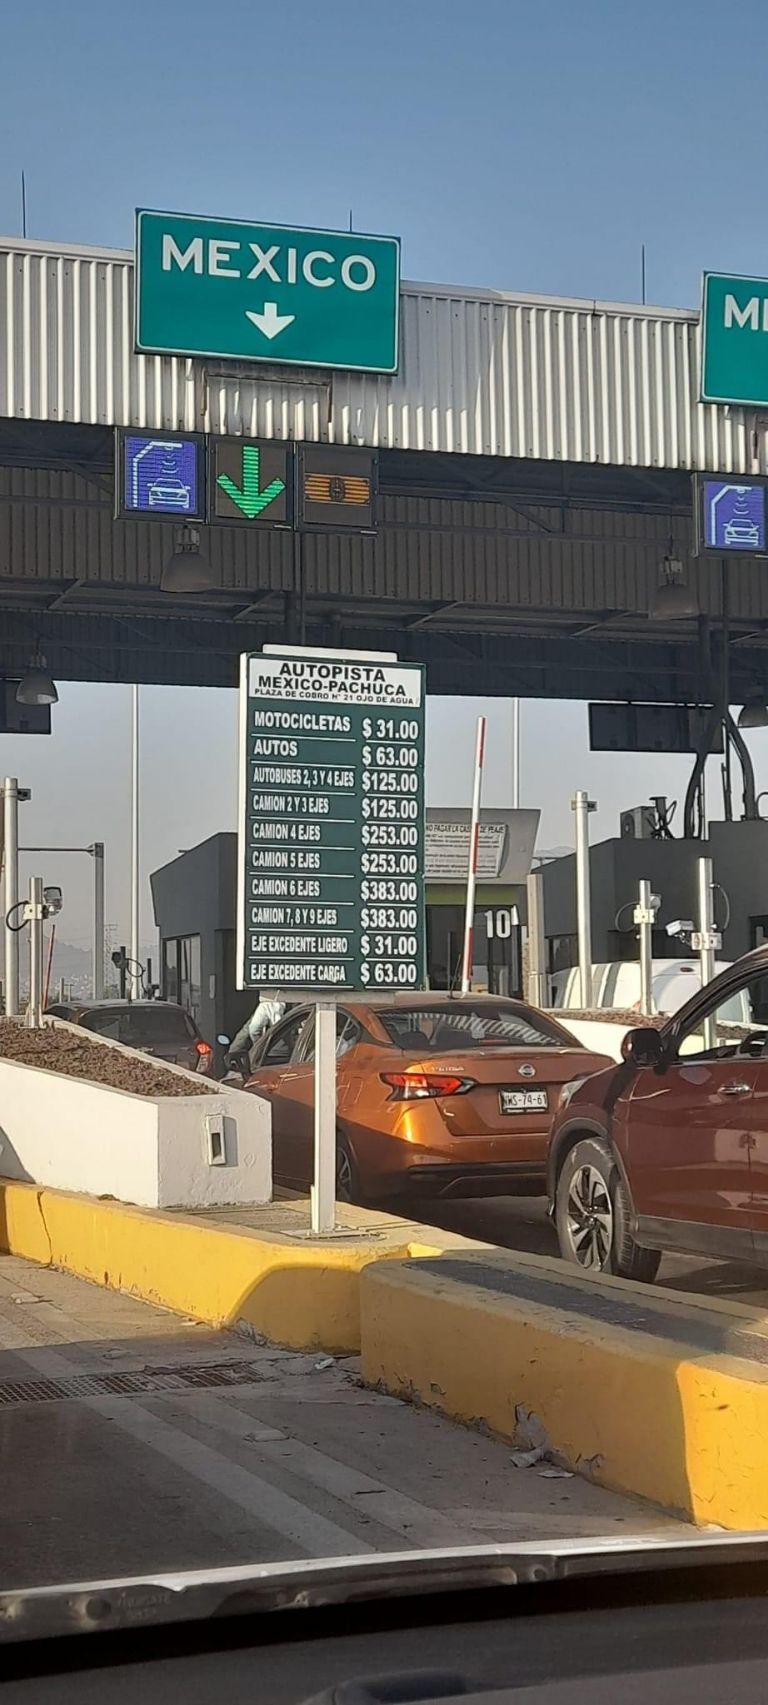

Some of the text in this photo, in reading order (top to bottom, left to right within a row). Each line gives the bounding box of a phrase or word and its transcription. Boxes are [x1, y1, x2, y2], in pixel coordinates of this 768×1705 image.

[162, 233, 376, 291] MEXICO
[279, 663, 386, 682] AUTOPISTA
[255, 688, 282, 697] PLAZA
[286, 690, 297, 698] DE
[300, 691, 329, 700] COBRO
[389, 697, 414, 705] AGUA
[258, 676, 406, 696] MEXICO-PACHUCA
[254, 711, 418, 740] MOTOCICLETAS $ 31.00
[254, 739, 418, 766] AUTOS $ 63.00
[253, 767, 418, 793] AUTOBUSES 2, 3 Y 4 EJES $125.00
[253, 795, 418, 820] CAMION 2 Y 3 EJES $125.00
[253, 823, 418, 846] CAMION 4 EJES $253.00
[252, 851, 418, 874] CAMION 5 EJES $253.00
[252, 879, 417, 901] CAMION 6 EJES $383.00
[251, 907, 417, 929] CAMION 7, 8 Y 9 EJES $383.00
[484, 910, 511, 939] 10
[251, 934, 417, 956] EJE EXCEDENTE LIGERO $ 31.00
[251, 962, 417, 984] EJE EXCEDENTE CARGA $ 63.00
